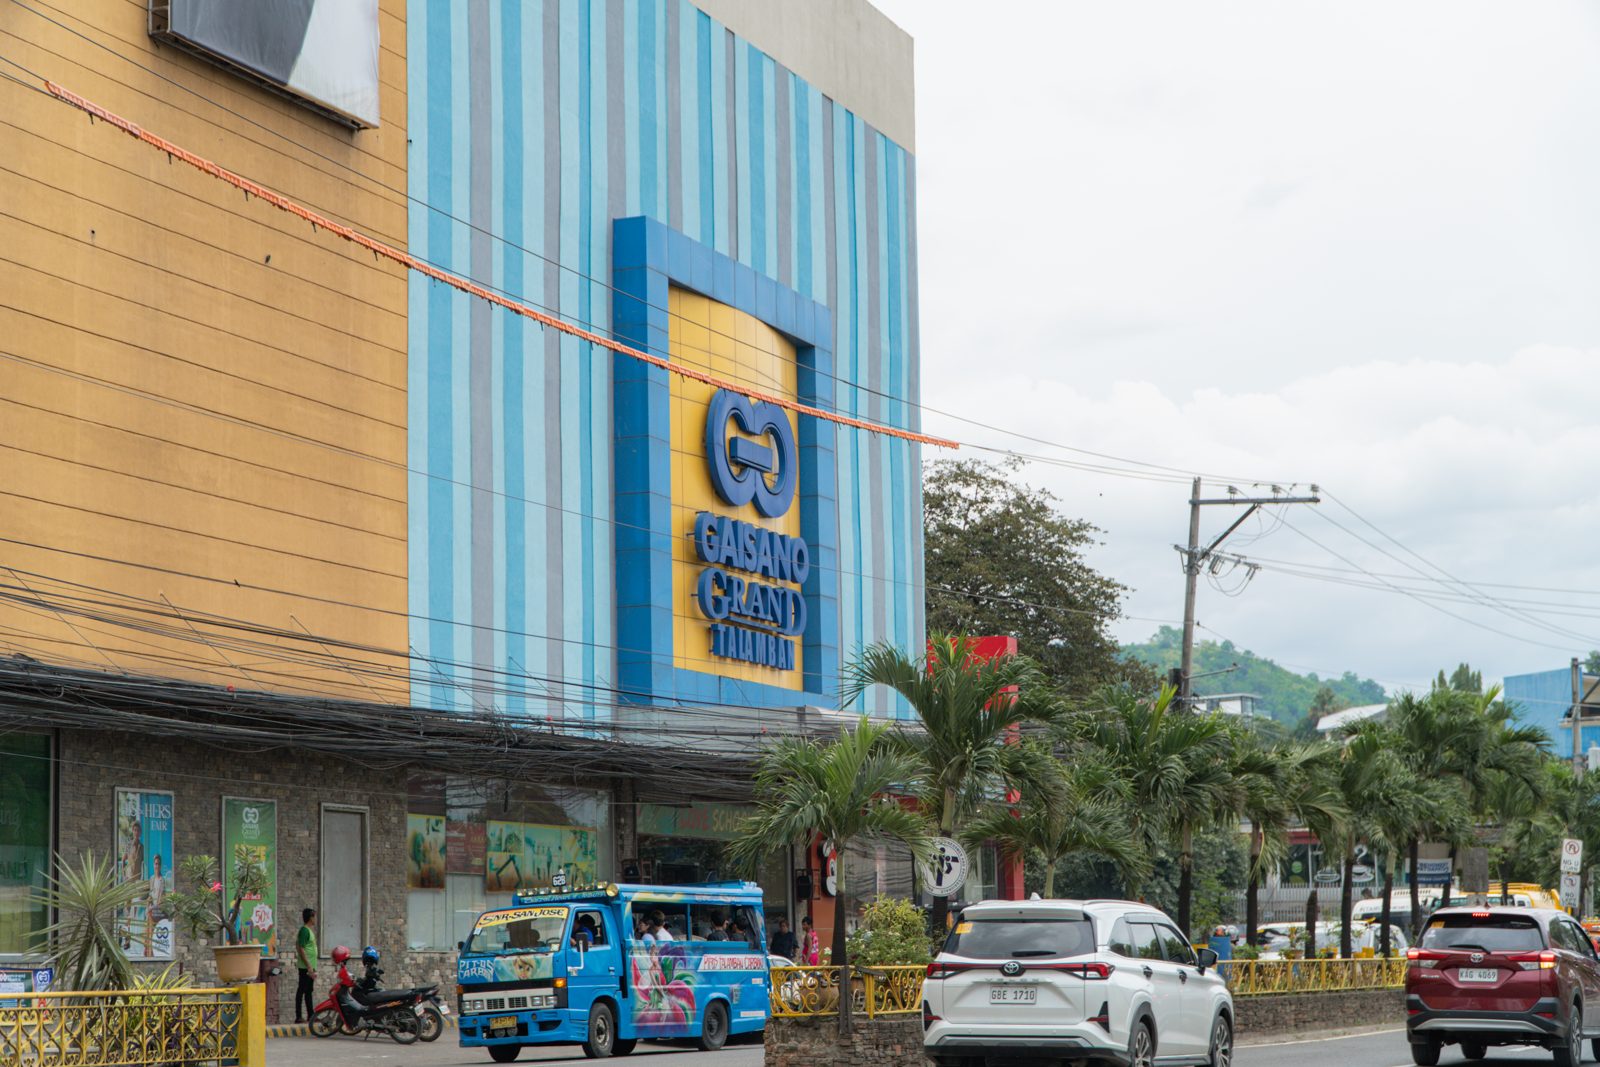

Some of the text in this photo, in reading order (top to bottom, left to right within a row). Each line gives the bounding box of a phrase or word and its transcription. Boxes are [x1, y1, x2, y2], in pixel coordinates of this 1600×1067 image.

[694, 511, 809, 584] GAISANO
[698, 567, 808, 636] GRAND
[711, 623, 795, 671] TALAMBAN
[145, 803, 172, 819] HERS
[1460, 971, 1496, 979] KAG 4069
[991, 990, 1035, 1000] GBE 1710
